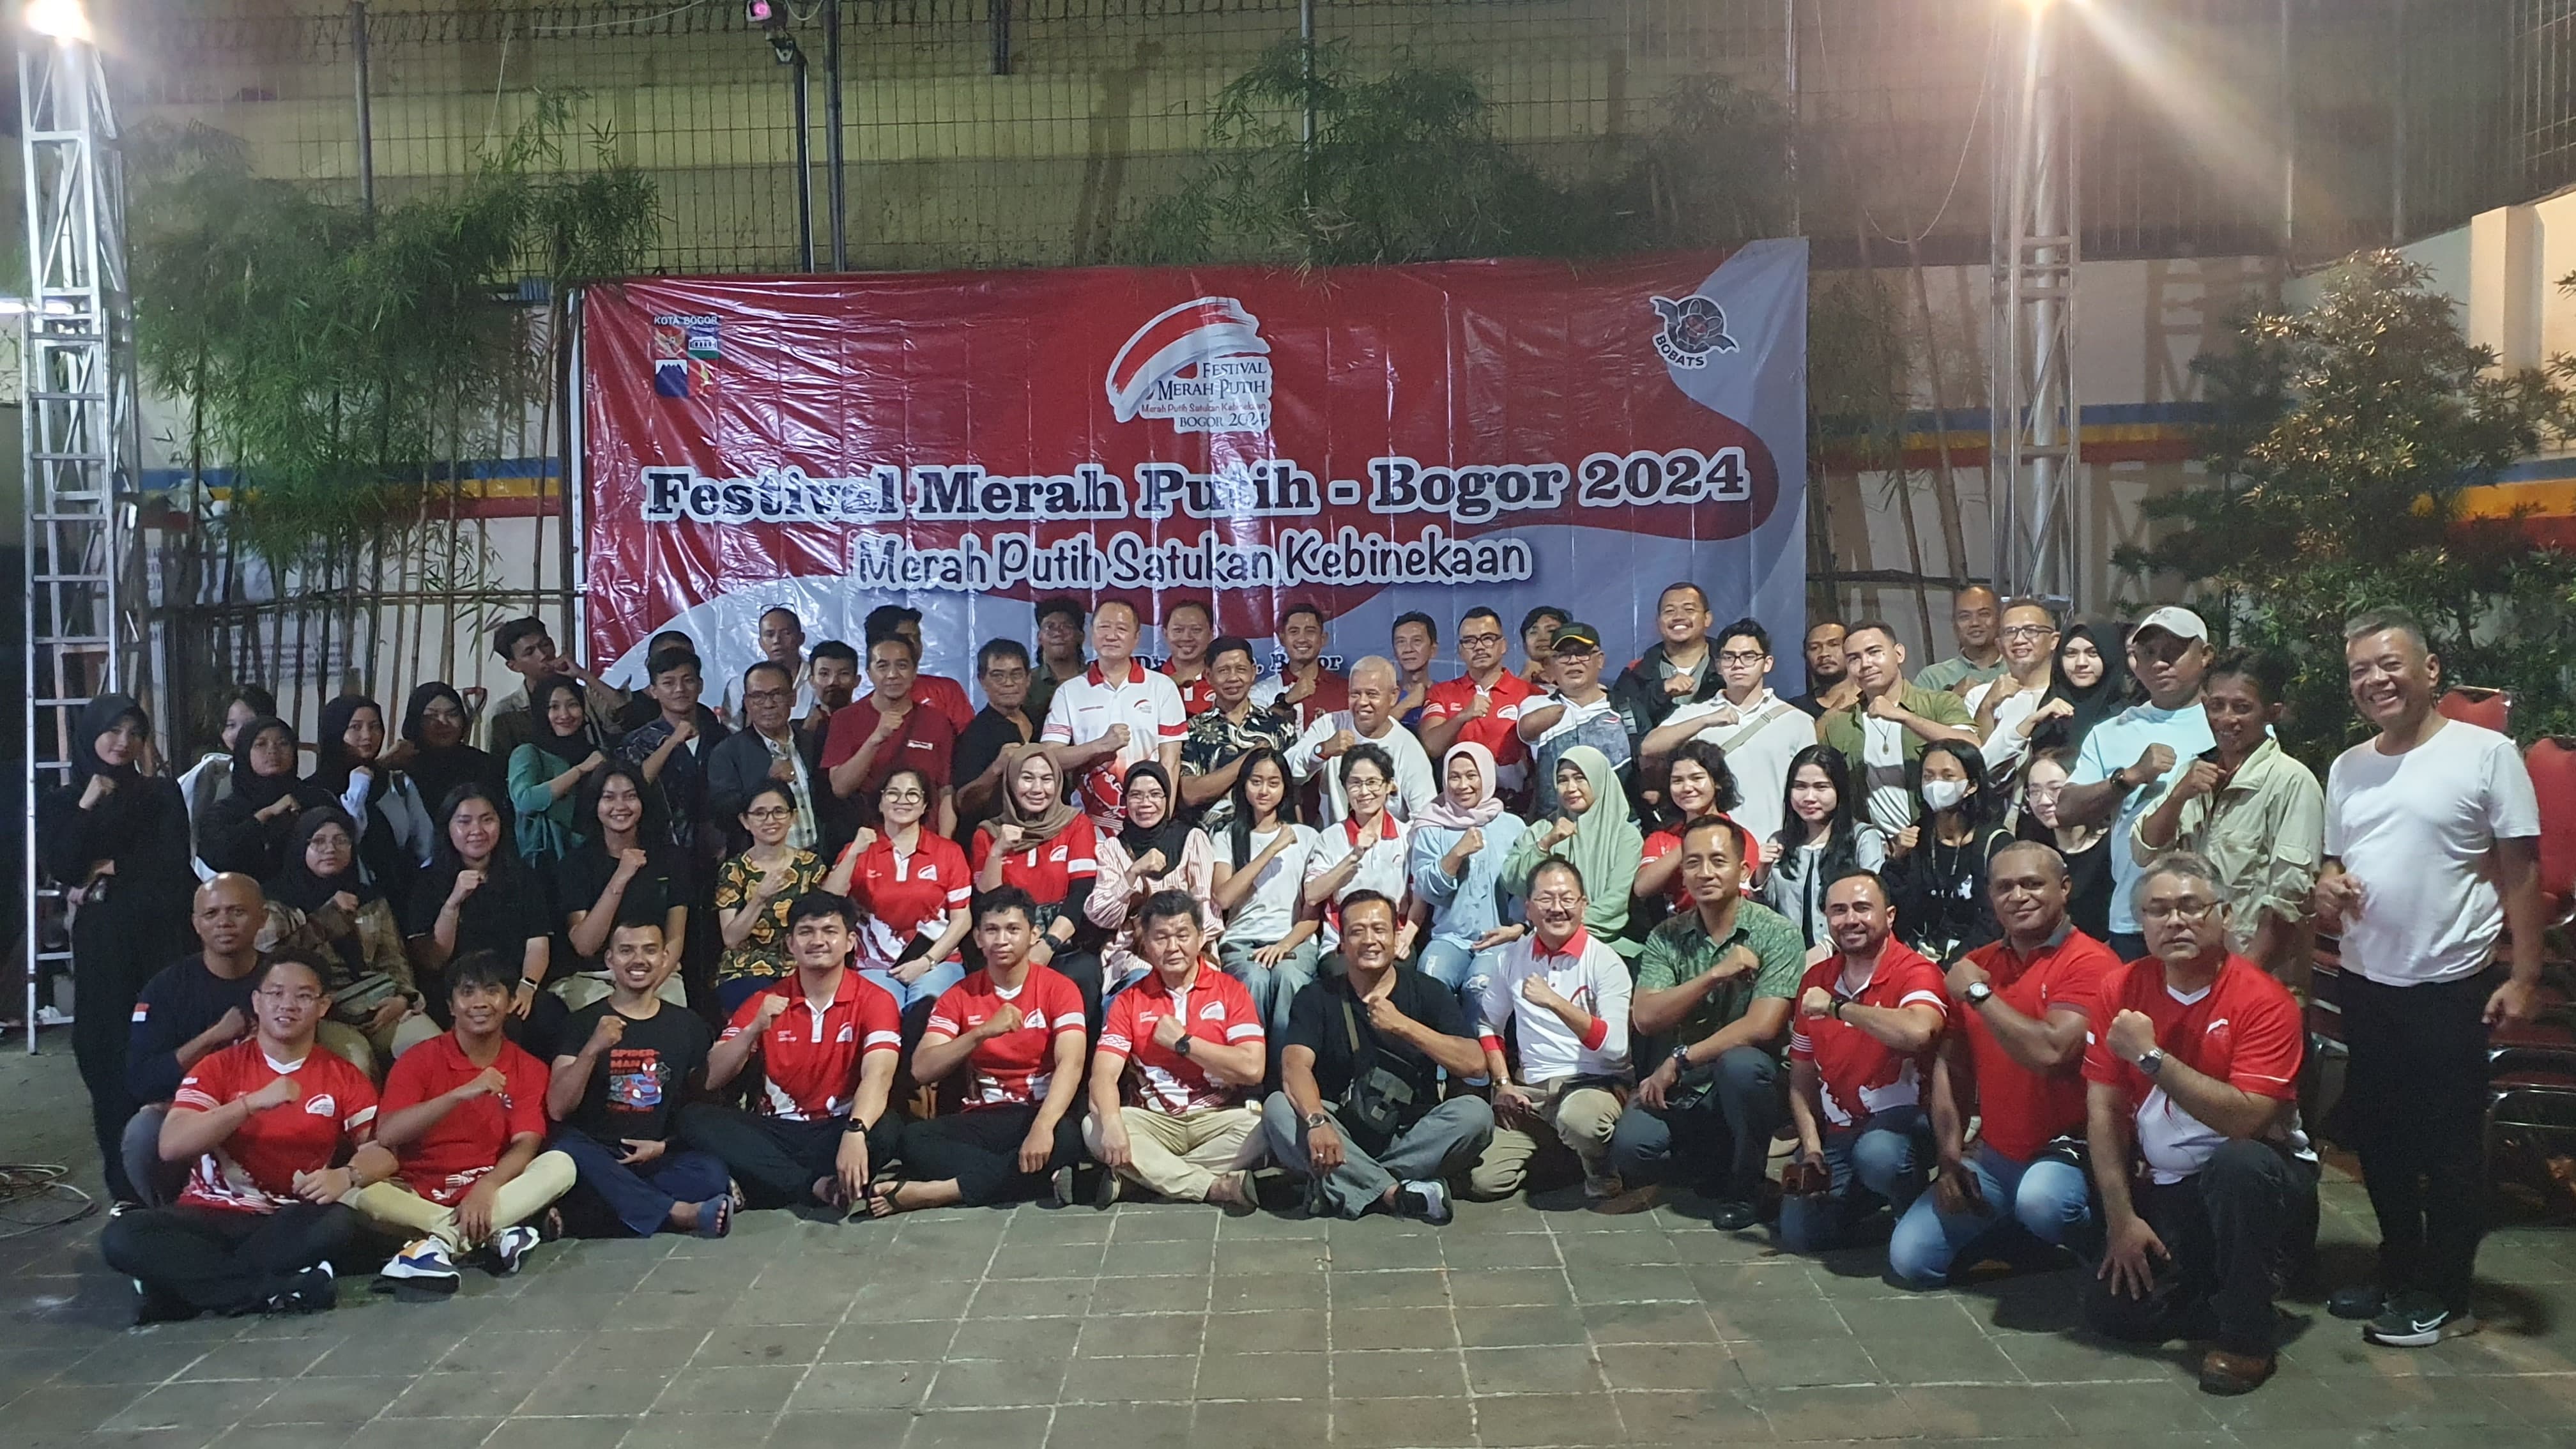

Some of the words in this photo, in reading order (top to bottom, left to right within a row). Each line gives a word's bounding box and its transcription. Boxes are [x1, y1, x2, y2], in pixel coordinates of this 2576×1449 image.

[654, 316, 679, 325] KOTA
[683, 316, 720, 325] BOGOR
[1655, 334, 1705, 367] BOBATS
[1202, 362, 1267, 378] FESTIVAL
[1158, 380, 1214, 401] MERAH
[1220, 378, 1266, 399] PUTIH
[1179, 416, 1223, 427] BOGOR
[647, 472, 898, 516] Festival
[918, 470, 1121, 514] Merah
[1374, 463, 1564, 516] Bogor
[1584, 454, 1744, 500] 2024
[859, 539, 987, 583] Merah
[999, 538, 1101, 583] Putih
[1113, 535, 1274, 582] Satukan
[1286, 531, 1526, 578] Kebinekaan
[1270, 653, 1342, 671] Bor
